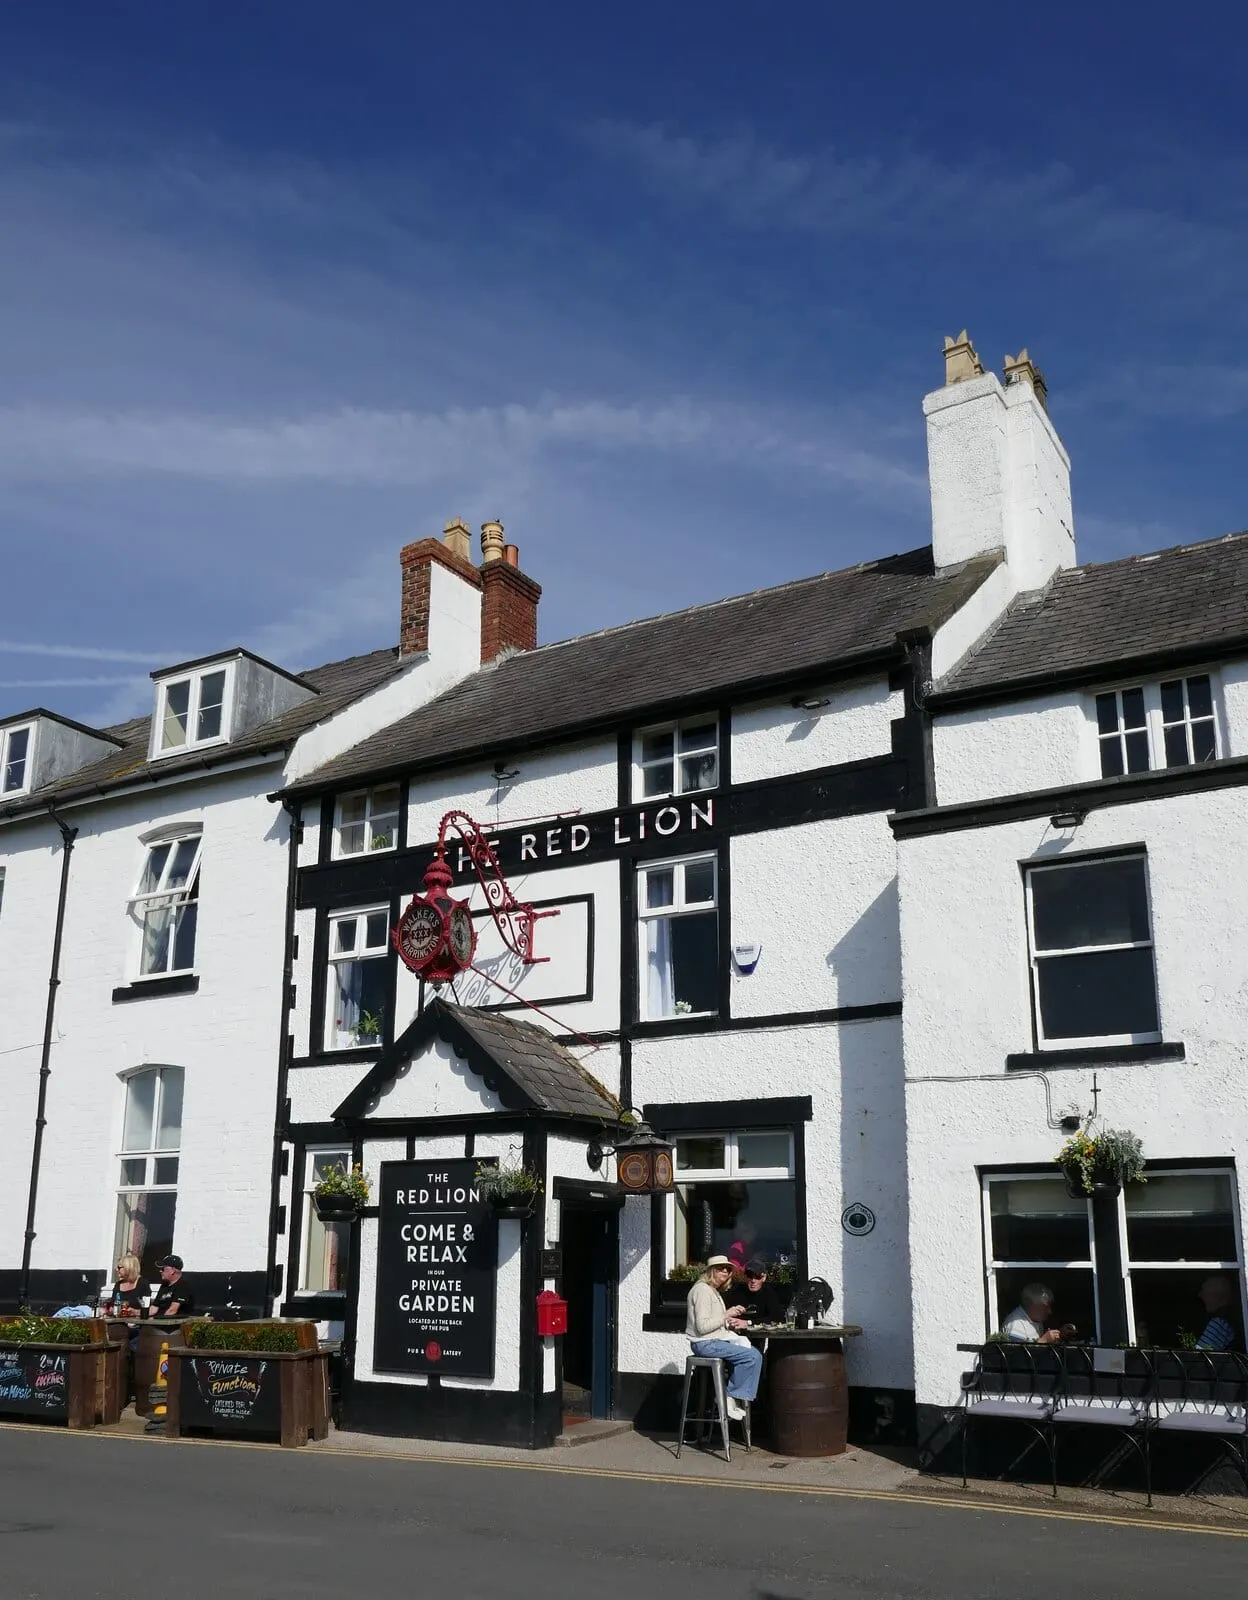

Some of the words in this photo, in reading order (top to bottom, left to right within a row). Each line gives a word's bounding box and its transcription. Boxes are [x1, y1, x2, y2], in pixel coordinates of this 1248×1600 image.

[521, 825, 591, 861] RED
[614, 799, 714, 844] LION
[403, 909, 440, 931] WALKER'S
[412, 929, 429, 938] XXX
[402, 935, 440, 959] WARRINGTON
[427, 1173, 449, 1183] THE
[396, 1189, 429, 1204] RED
[435, 1188, 480, 1203] LION
[401, 1224, 456, 1241] COME
[462, 1224, 475, 1241] &
[407, 1245, 467, 1263] RELAX
[411, 1279, 462, 1291] PRIVATE
[399, 1294, 474, 1313] GARDEN
[205, 1361, 249, 1374] Private
